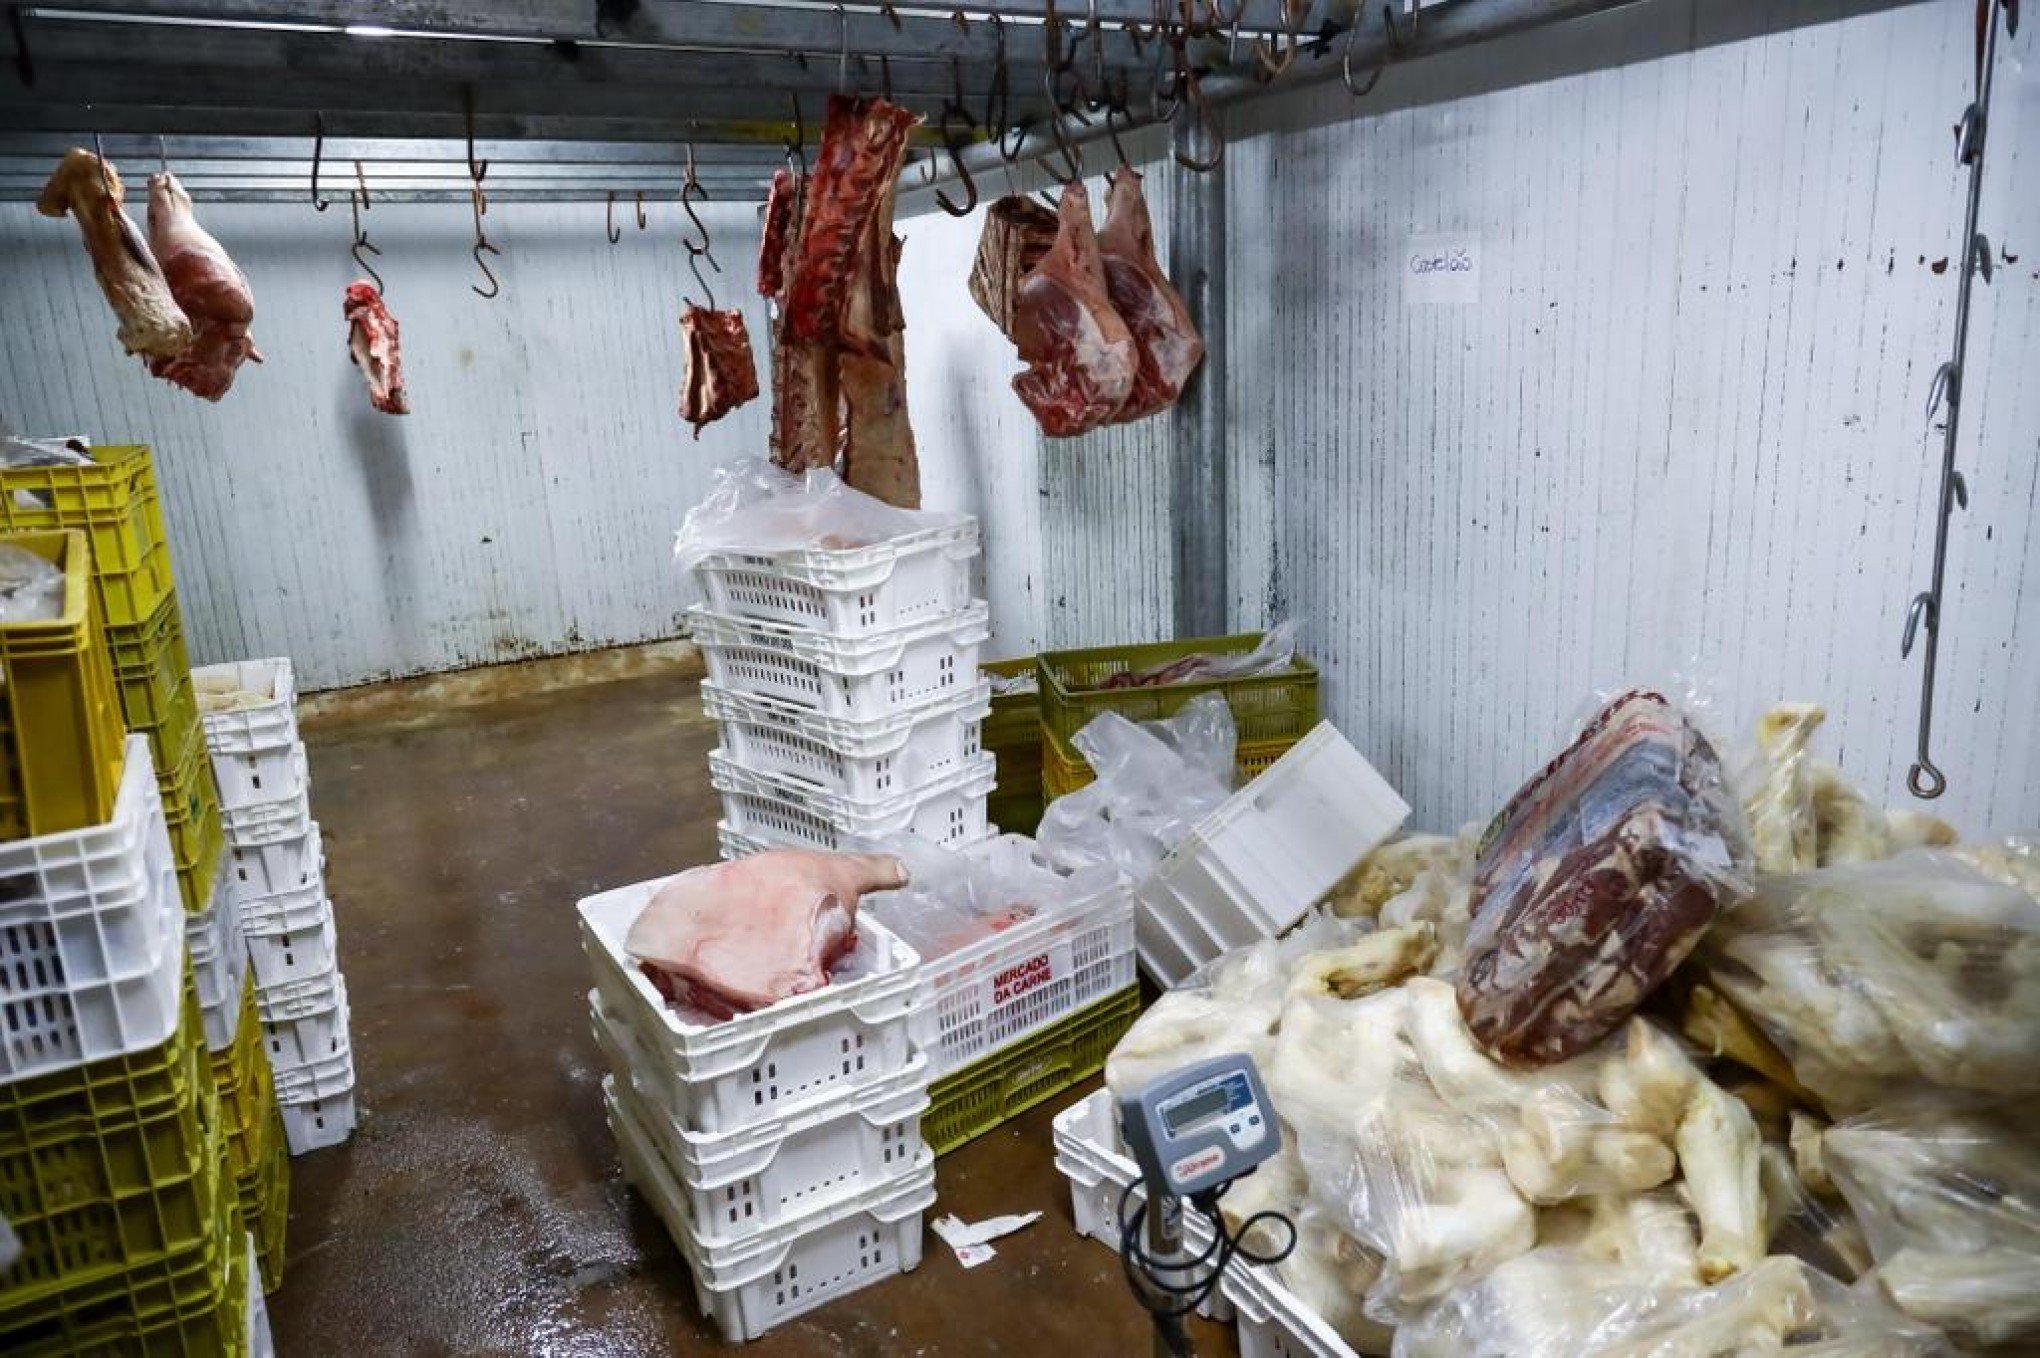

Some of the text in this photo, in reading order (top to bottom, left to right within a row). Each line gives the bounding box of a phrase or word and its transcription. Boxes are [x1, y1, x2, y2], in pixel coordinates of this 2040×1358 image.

[993, 953, 1049, 988] MERCADO
[994, 967, 1052, 1004] DA CARNE
